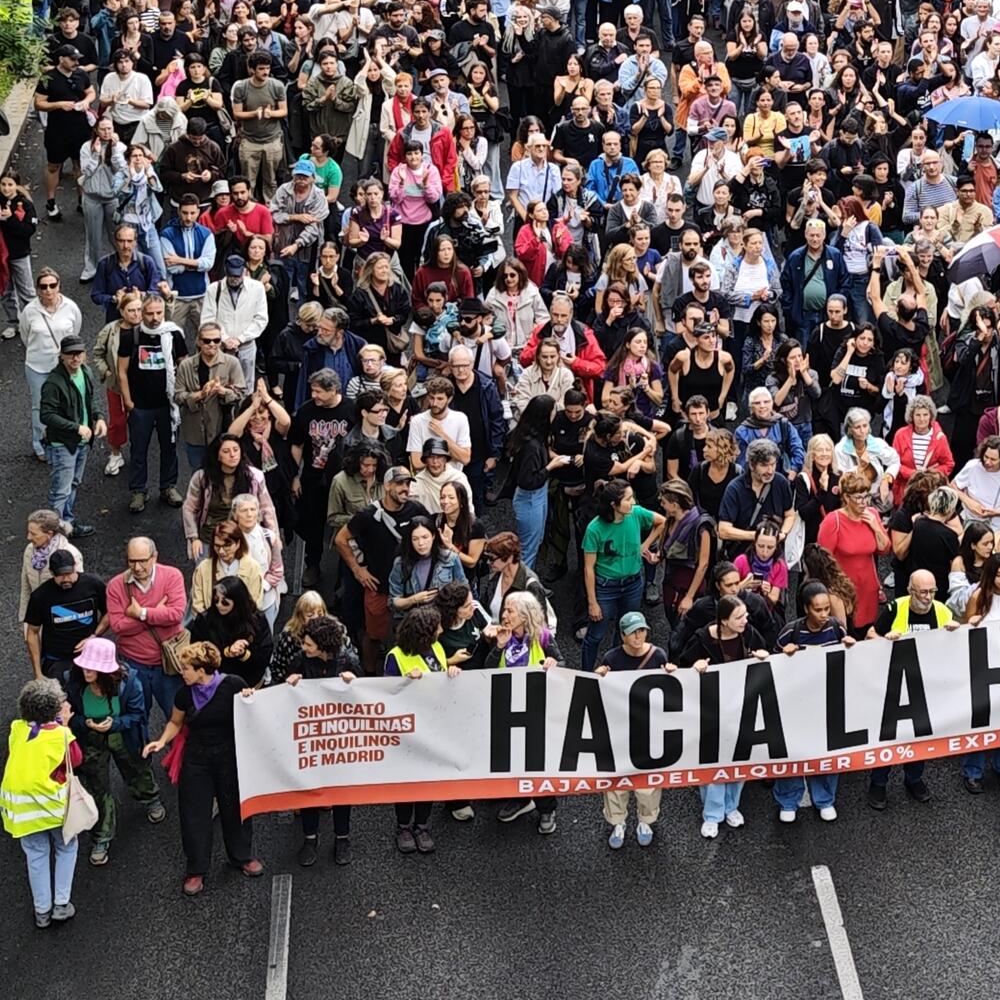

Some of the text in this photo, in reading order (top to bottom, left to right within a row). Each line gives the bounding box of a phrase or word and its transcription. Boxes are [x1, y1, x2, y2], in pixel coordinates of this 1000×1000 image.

[308, 418, 349, 438] AC/DC
[297, 702, 386, 719] SINDICATO
[489, 660, 789, 774] HACIA
[826, 637, 934, 752] LA
[297, 717, 412, 738] DE INQUILINAS
[298, 735, 401, 755] E INQUILINOS
[298, 749, 385, 770] DE MADRID
[518, 777, 634, 794] BAJADA
[647, 769, 700, 785] DEL
[712, 756, 852, 781] ALQUILER
[863, 744, 915, 766] 50%
